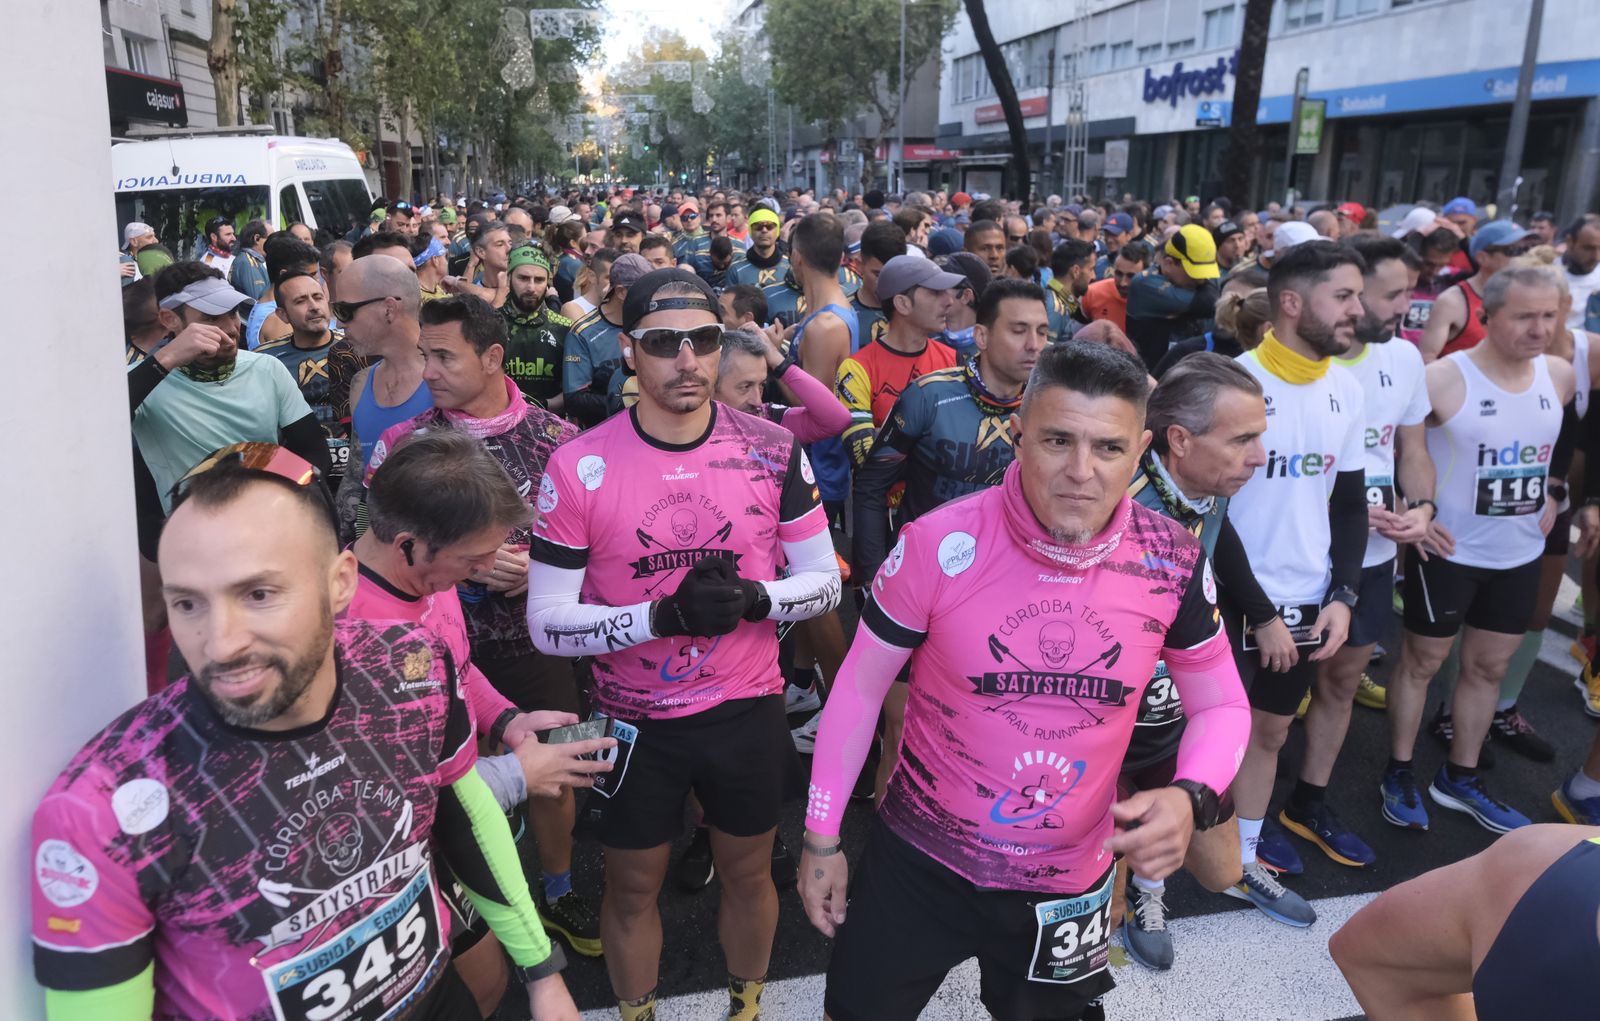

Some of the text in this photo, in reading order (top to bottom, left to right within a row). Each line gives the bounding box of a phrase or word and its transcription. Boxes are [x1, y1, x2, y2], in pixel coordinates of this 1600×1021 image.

[146, 89, 175, 111] cajasur
[1143, 57, 1226, 109] bofrost
[1478, 440, 1552, 467] indea
[661, 472, 700, 482] TEAMERGY
[1487, 476, 1542, 502] 116
[641, 492, 727, 529] CÓRDOBA TEAM
[1038, 574, 1085, 584] TEAMERGY
[999, 598, 1115, 643] CÓRDOBA TEAM
[995, 672, 1110, 700] SATYSTRAIL
[1001, 709, 1093, 741] TRAIL RUNNING
[284, 753, 347, 790] TEAMERGY
[264, 778, 400, 872] CÓRDOBA TEAM
[288, 854, 411, 933] SATYSTRAIL
[1053, 900, 1091, 920] SUBIDA
[296, 874, 426, 980] SUBIDA ERMITAS
[302, 901, 427, 1021] 345
